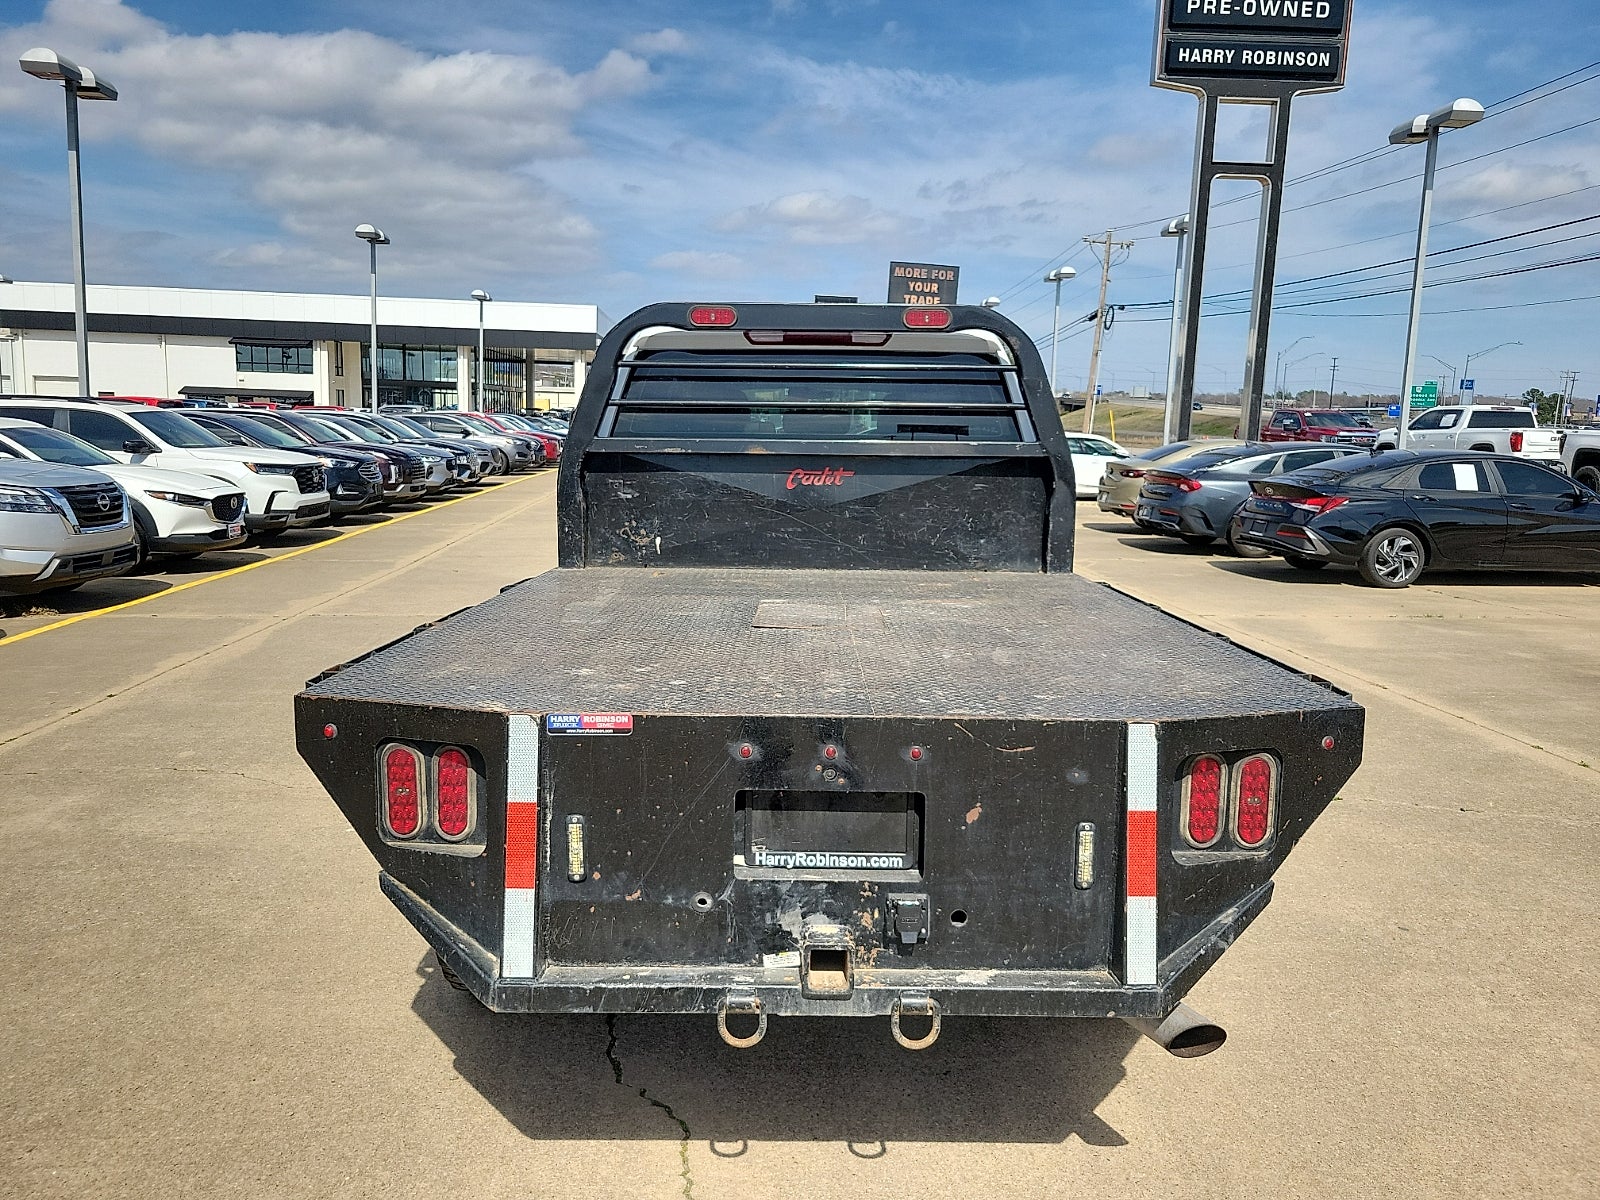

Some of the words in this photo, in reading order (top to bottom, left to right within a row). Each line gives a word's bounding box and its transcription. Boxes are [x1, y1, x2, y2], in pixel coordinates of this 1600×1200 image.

[1186, 0, 1330, 19] PRE-OWNED
[1178, 48, 1235, 64] HARRY
[1241, 50, 1331, 67] ROBINSON
[894, 266, 928, 279] MORE
[931, 270, 954, 281] FOR
[908, 281, 939, 293] YOUR
[903, 294, 941, 305] TRADE
[785, 467, 855, 490] Cadet
[550, 715, 580, 723] HARRY
[583, 715, 629, 723] ROBINSON
[755, 852, 903, 869] HarryRobinson.com
